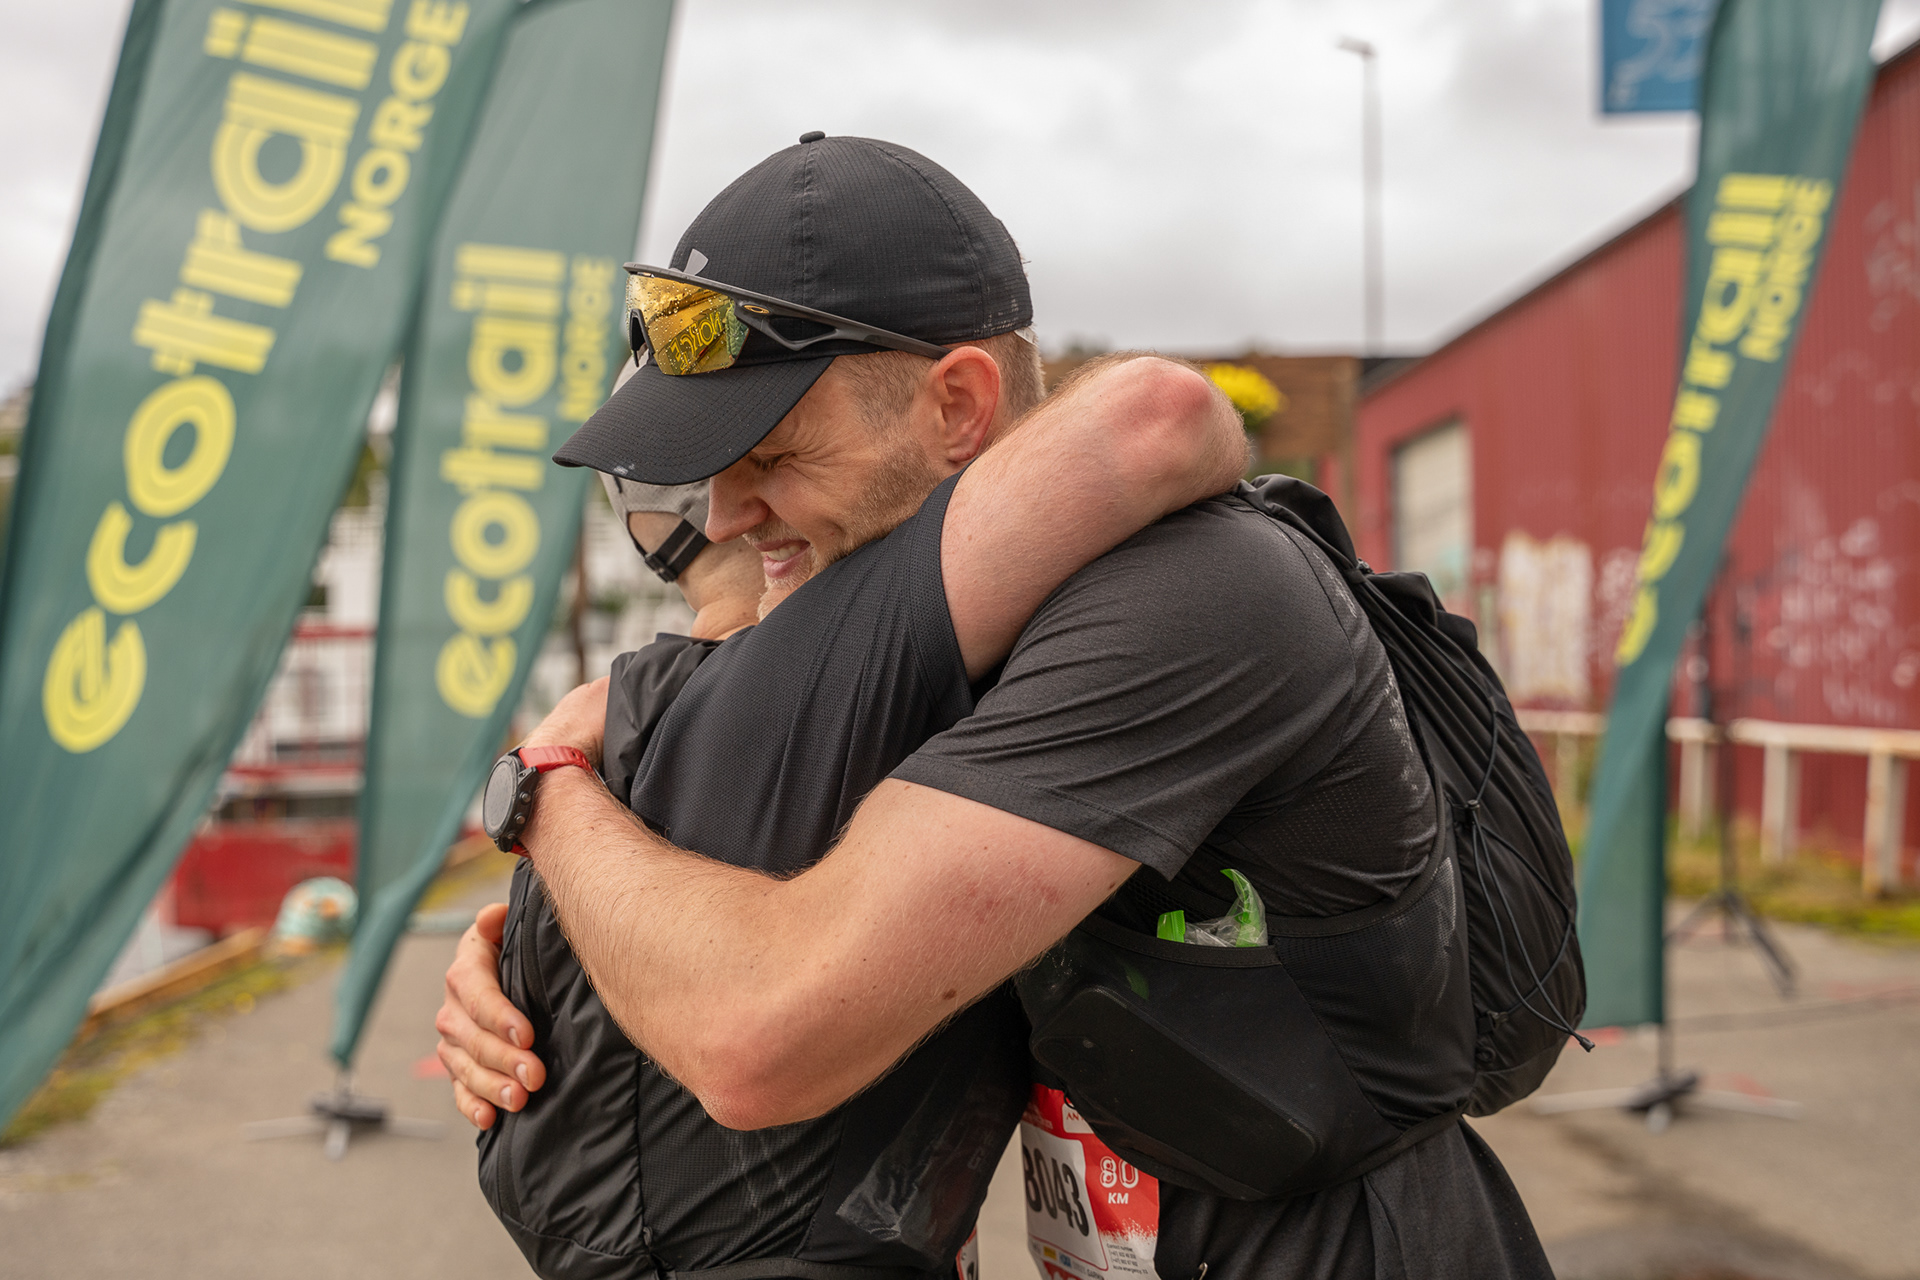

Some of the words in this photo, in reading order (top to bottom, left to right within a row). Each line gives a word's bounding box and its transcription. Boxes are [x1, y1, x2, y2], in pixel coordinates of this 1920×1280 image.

[324, 0, 470, 269] NORGE
[436, 242, 566, 716] ecotrail
[1100, 1156, 1139, 1188] 80
[1108, 1192, 1129, 1204] KM
